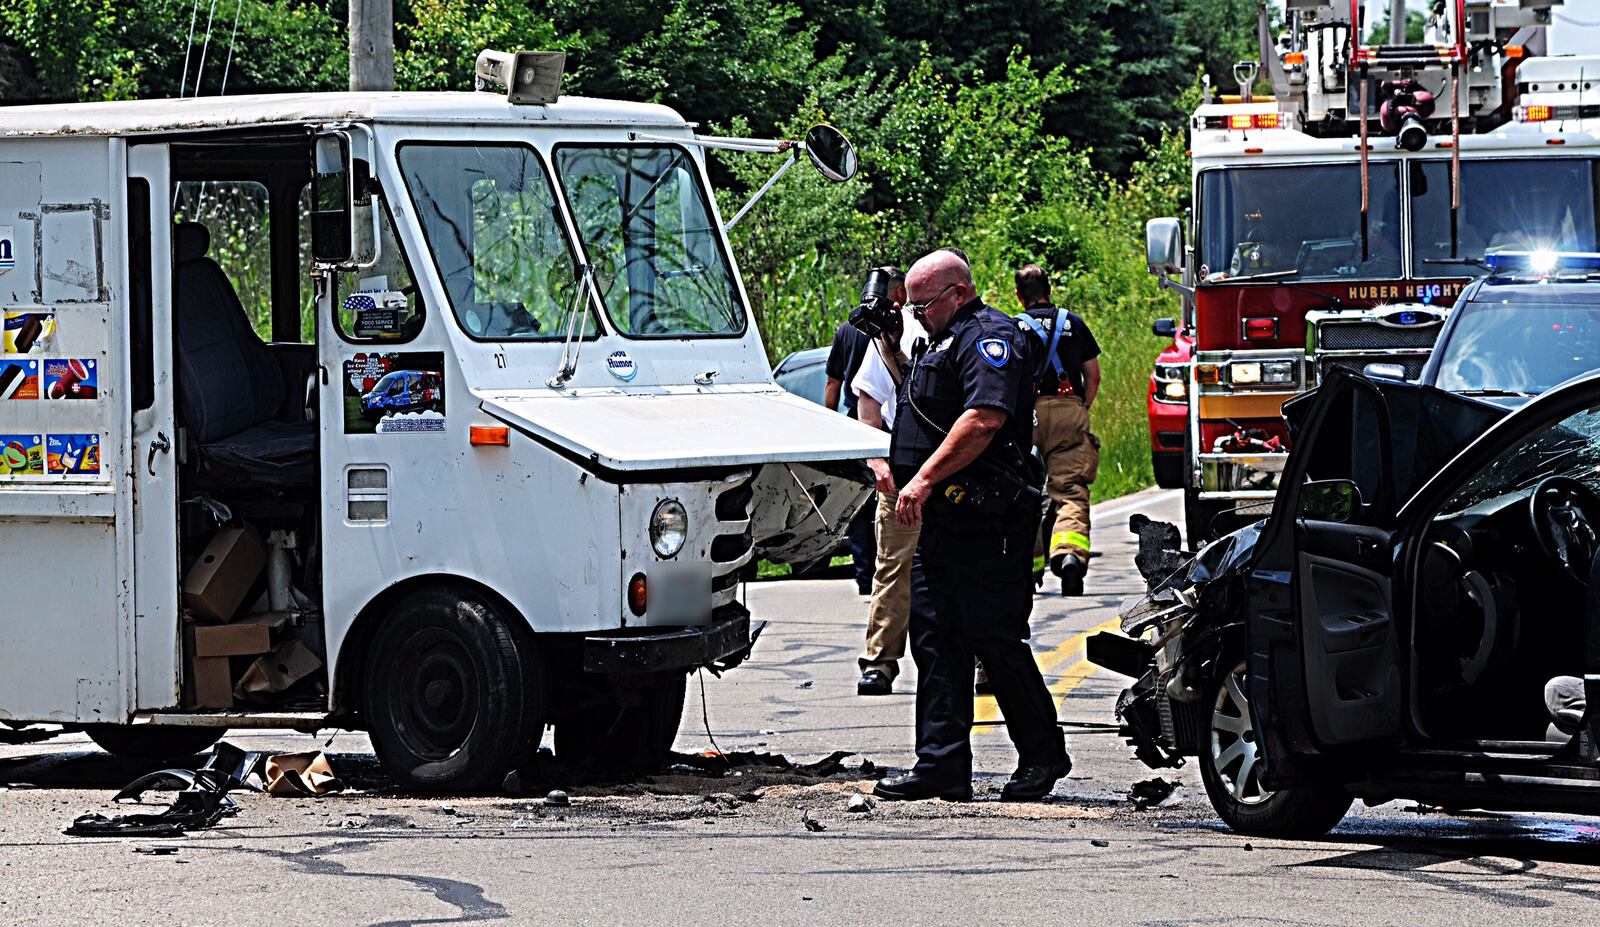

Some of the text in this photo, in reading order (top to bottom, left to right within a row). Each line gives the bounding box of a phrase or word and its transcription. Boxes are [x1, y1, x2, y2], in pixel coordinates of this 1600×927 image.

[1349, 284, 1467, 299] HUBER HEIGHT
[494, 353, 507, 369] 27
[607, 358, 633, 368] Humor
